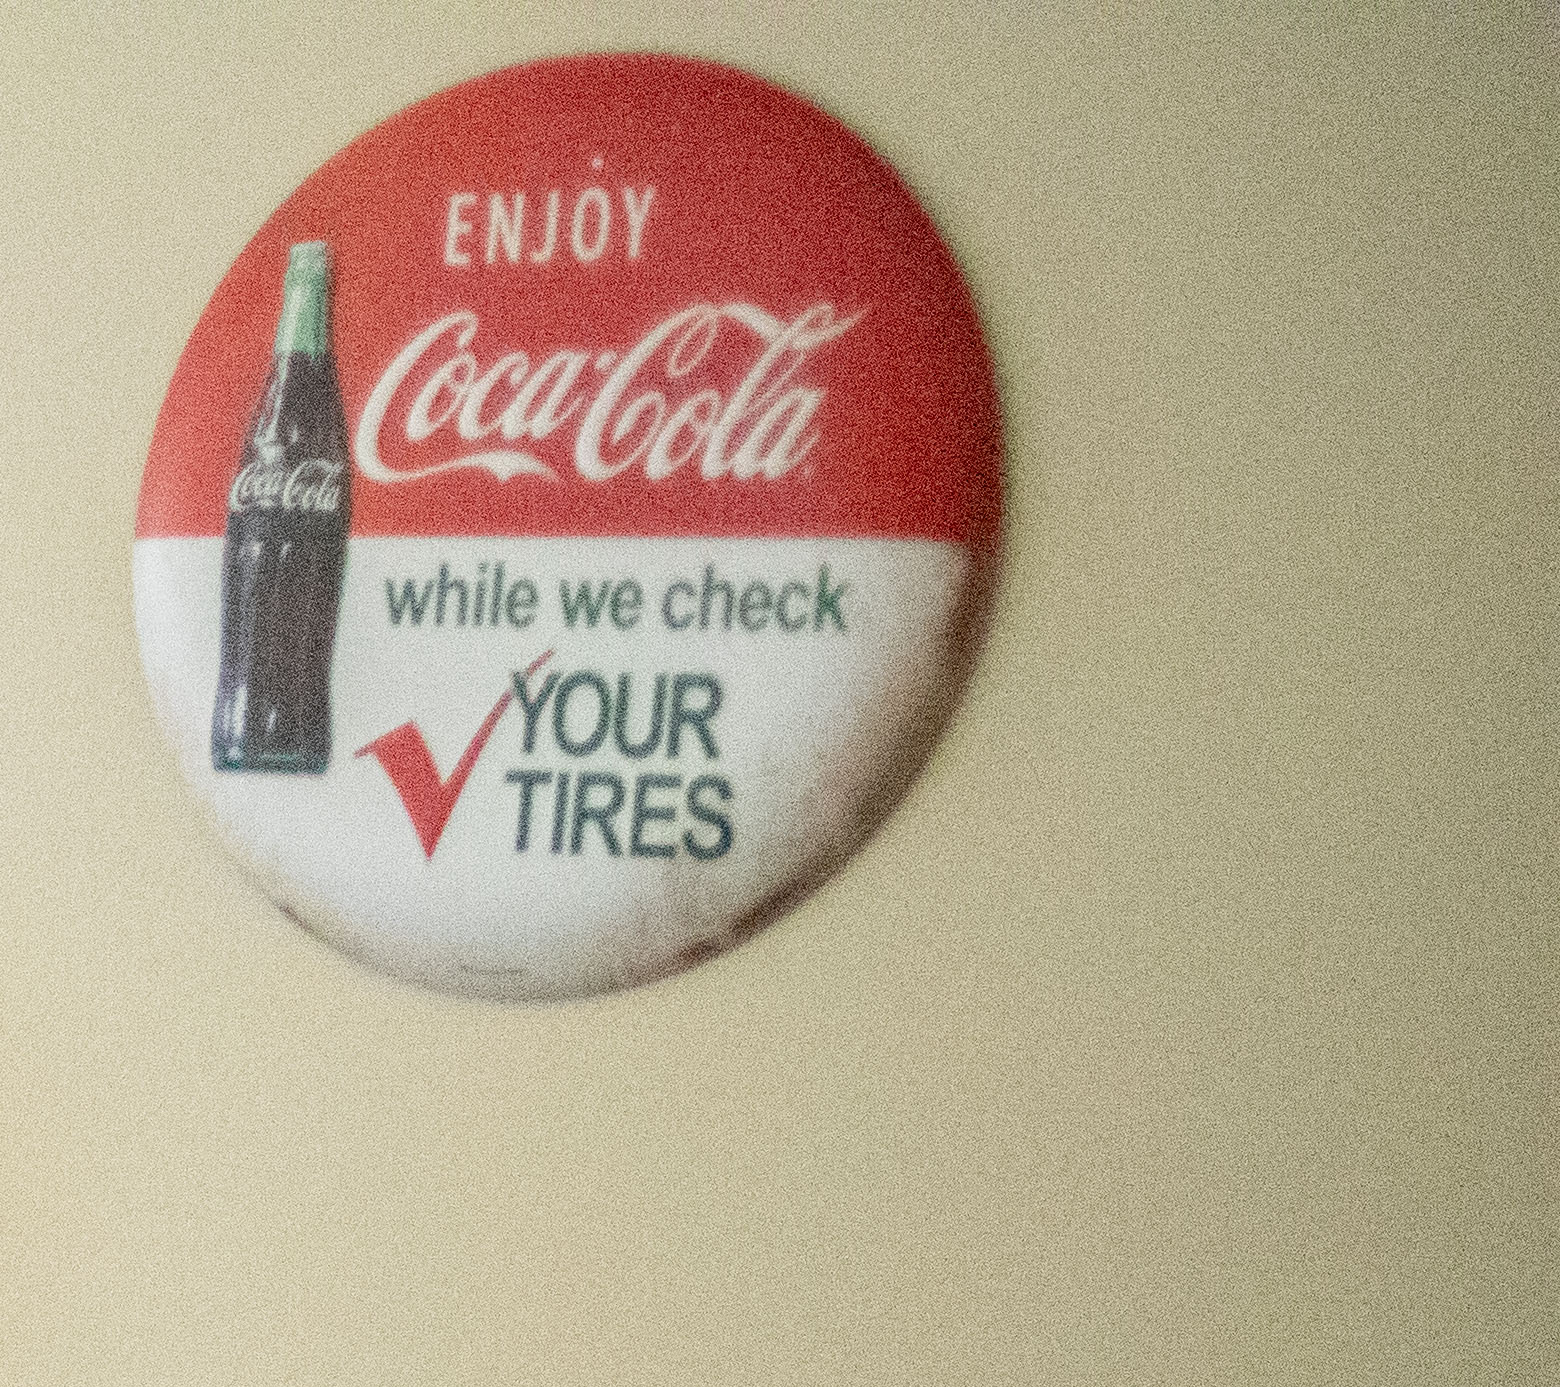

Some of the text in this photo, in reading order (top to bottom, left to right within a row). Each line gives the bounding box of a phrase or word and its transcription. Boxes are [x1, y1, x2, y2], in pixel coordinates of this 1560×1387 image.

[444, 184, 660, 268] ENJOY
[354, 301, 872, 485] Coca-Cola
[386, 560, 850, 634] while we check
[512, 672, 724, 760] YOUR
[504, 770, 736, 860] TIRES
